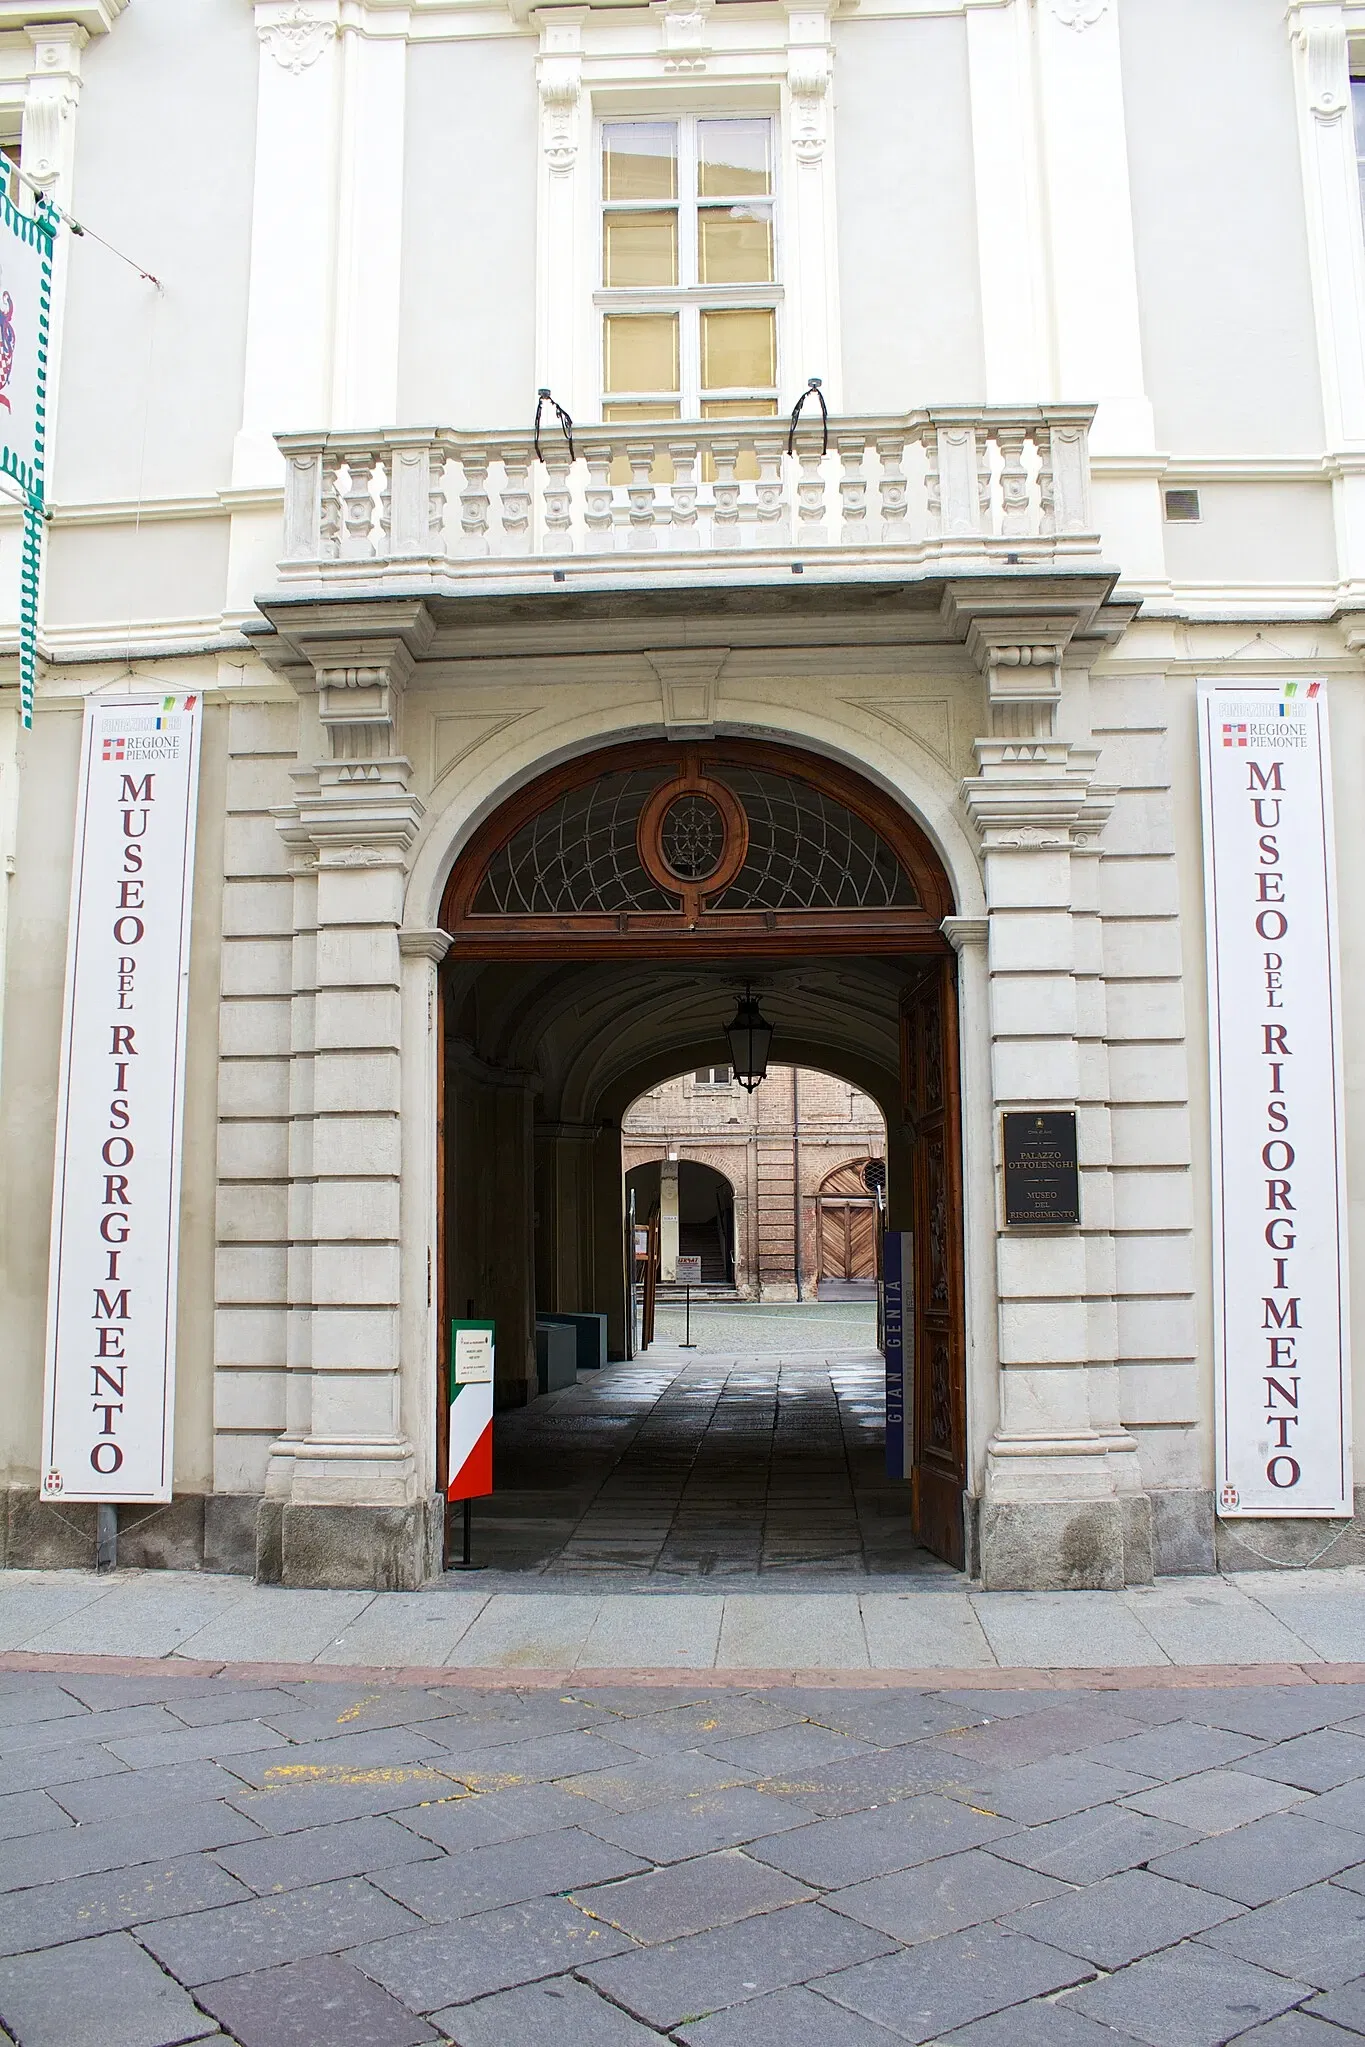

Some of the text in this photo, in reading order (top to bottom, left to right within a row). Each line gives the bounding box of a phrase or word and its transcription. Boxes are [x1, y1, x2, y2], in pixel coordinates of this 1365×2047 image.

[1250, 724, 1307, 735] REGIONE
[127, 736, 180, 748] REGIONE
[1250, 736, 1308, 747] PIEMONTE
[126, 749, 180, 760] PIEMONTE
[90, 773, 155, 1474] MUSEO DEL RISORGIMENTO
[1246, 761, 1303, 1488] MUSEO DEL RISORGIMENTO
[1020, 1151, 1061, 1159] PALAZZO
[1008, 1161, 1073, 1169] OTTOLENGHI
[1010, 1210, 1075, 1219] RISORGIMENTO
[886, 1281, 902, 1424] GIAN GENTA
